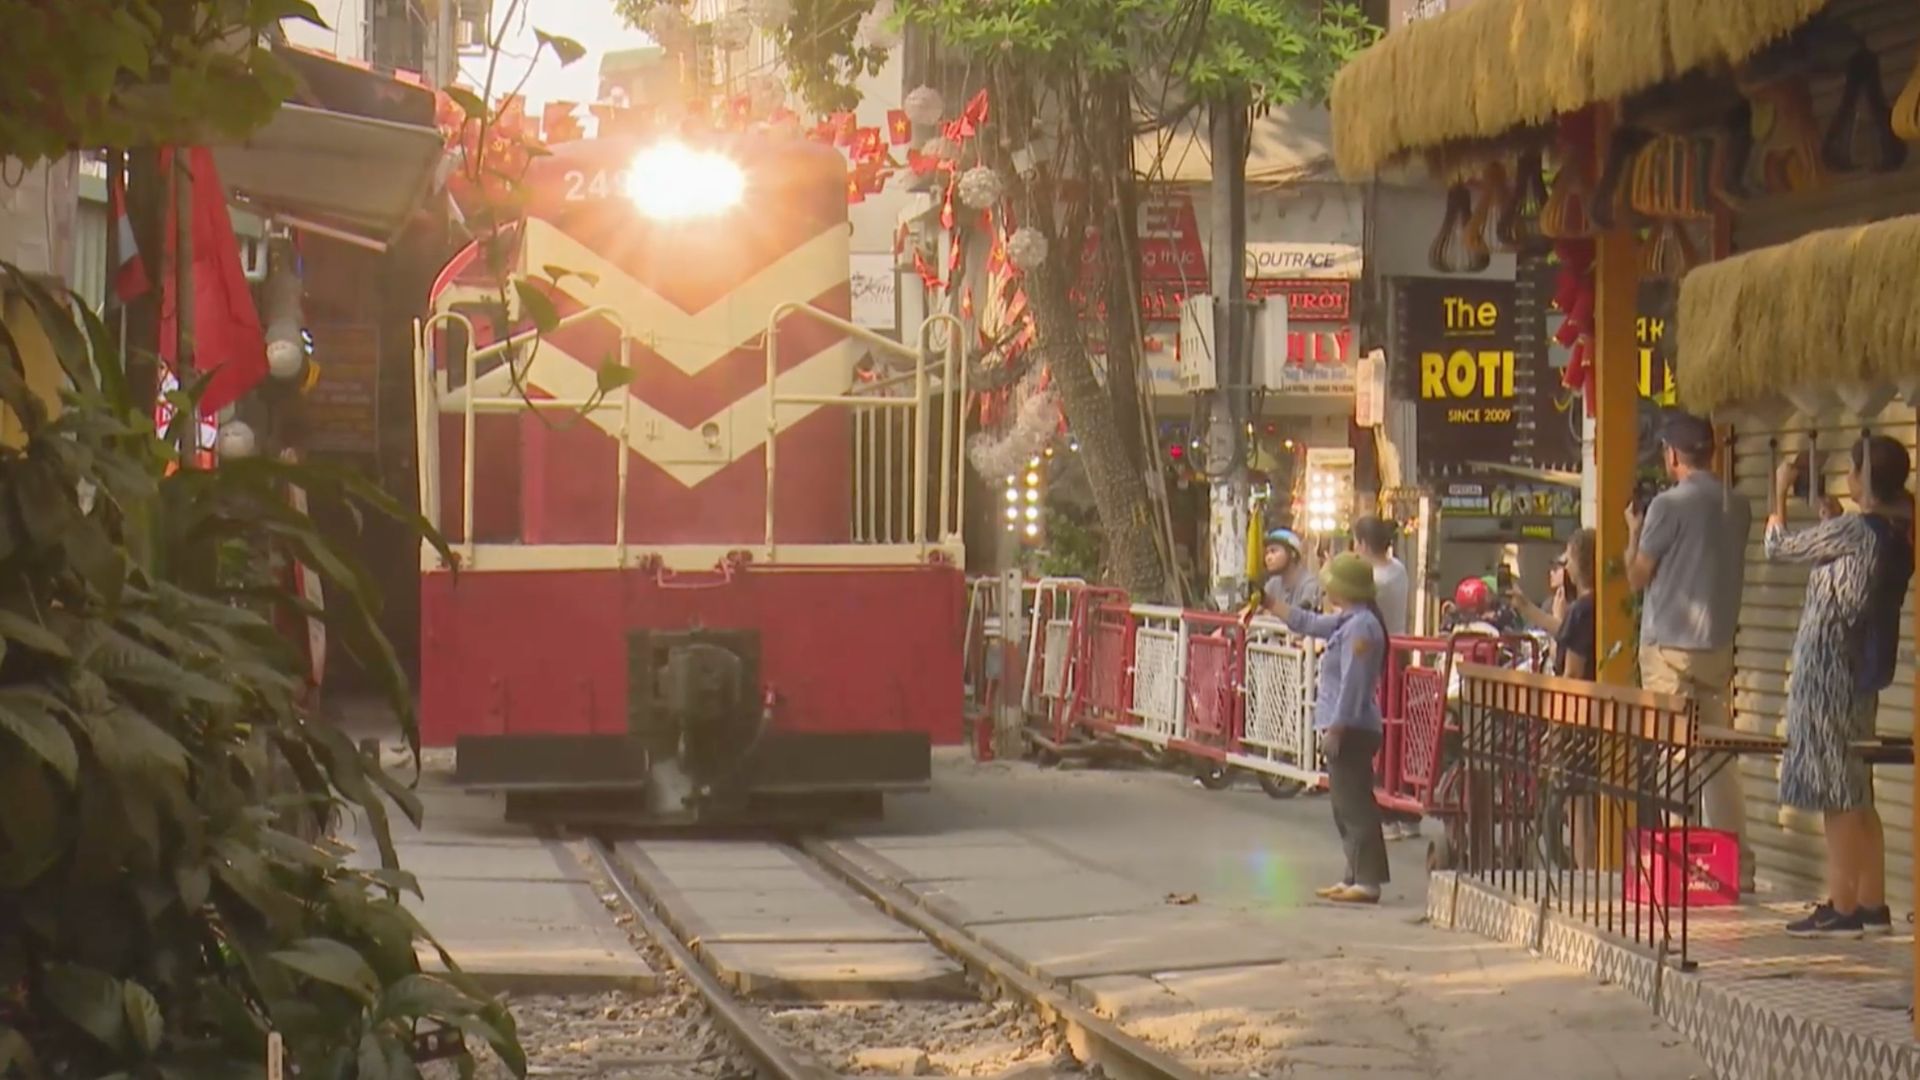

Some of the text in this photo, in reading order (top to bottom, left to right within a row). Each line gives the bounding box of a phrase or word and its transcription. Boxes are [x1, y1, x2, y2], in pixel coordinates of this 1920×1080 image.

[1443, 298, 1498, 328] The
[1421, 350, 1515, 399] ROTI
[1448, 407, 1511, 423] SINCE 2009
